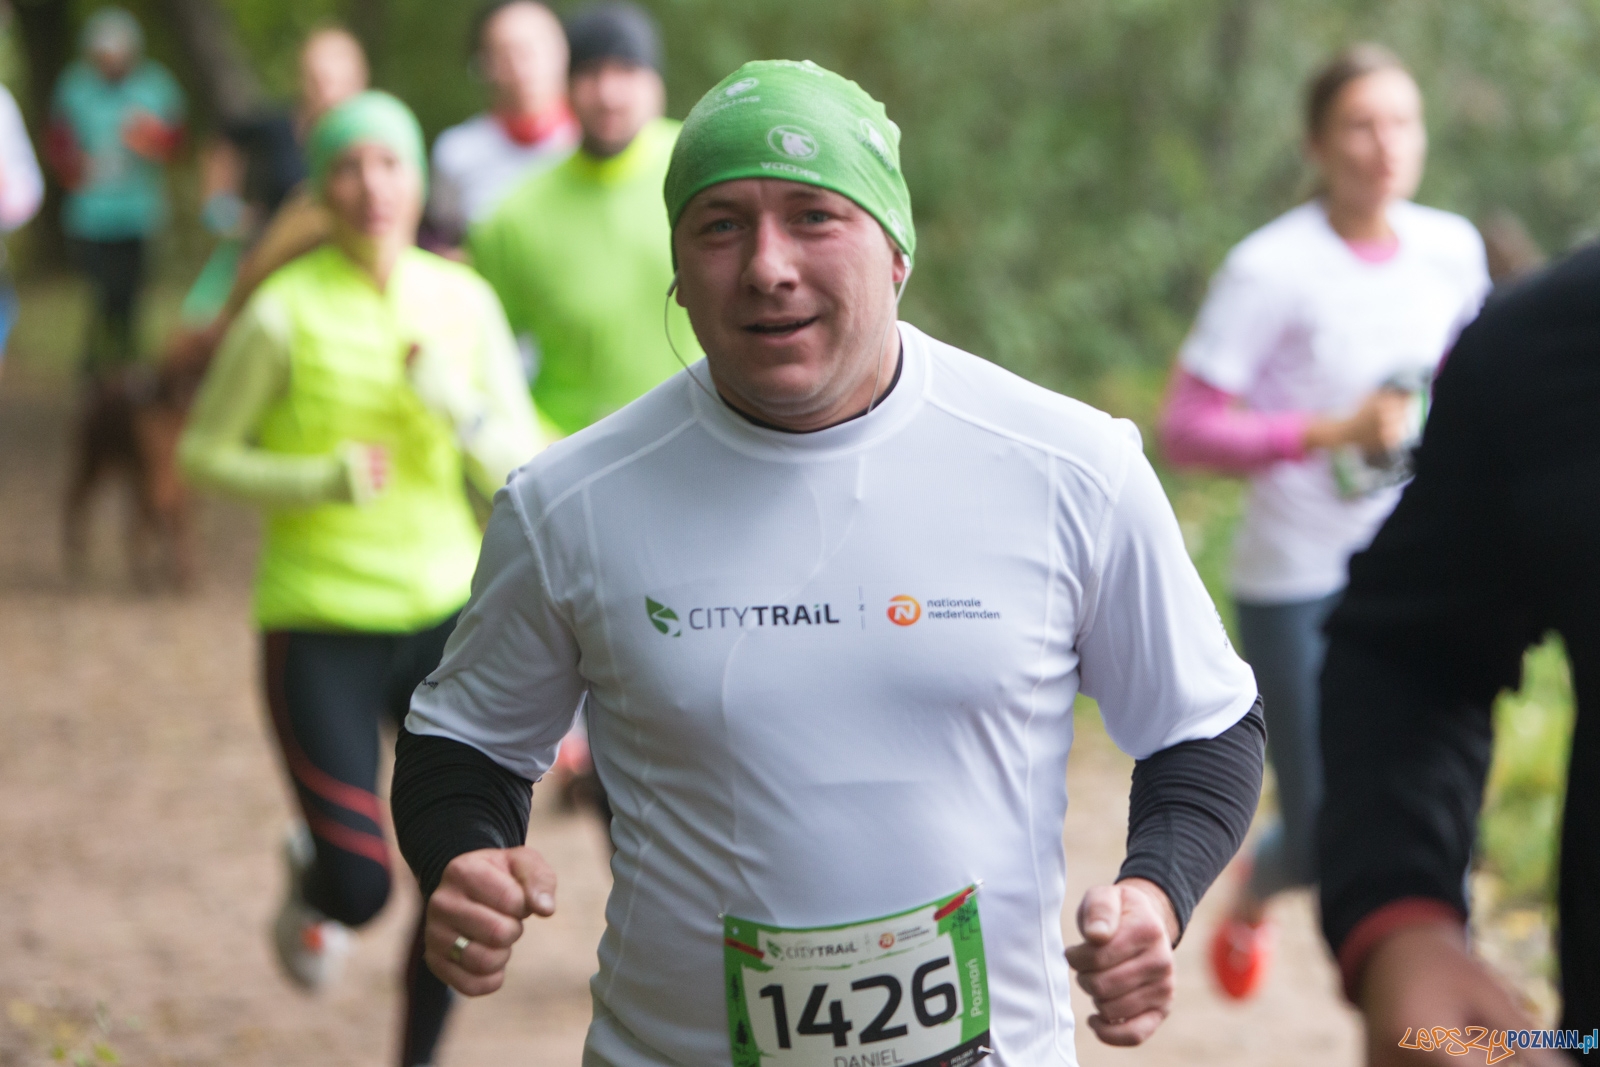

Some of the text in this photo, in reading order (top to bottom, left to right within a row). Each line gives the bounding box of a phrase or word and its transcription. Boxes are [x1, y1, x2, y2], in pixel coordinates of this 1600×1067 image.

[926, 597, 981, 608] nationale
[927, 609, 1001, 620] nederlanden
[758, 955, 958, 1050] 1426
[833, 1047, 904, 1067] DANIEL
